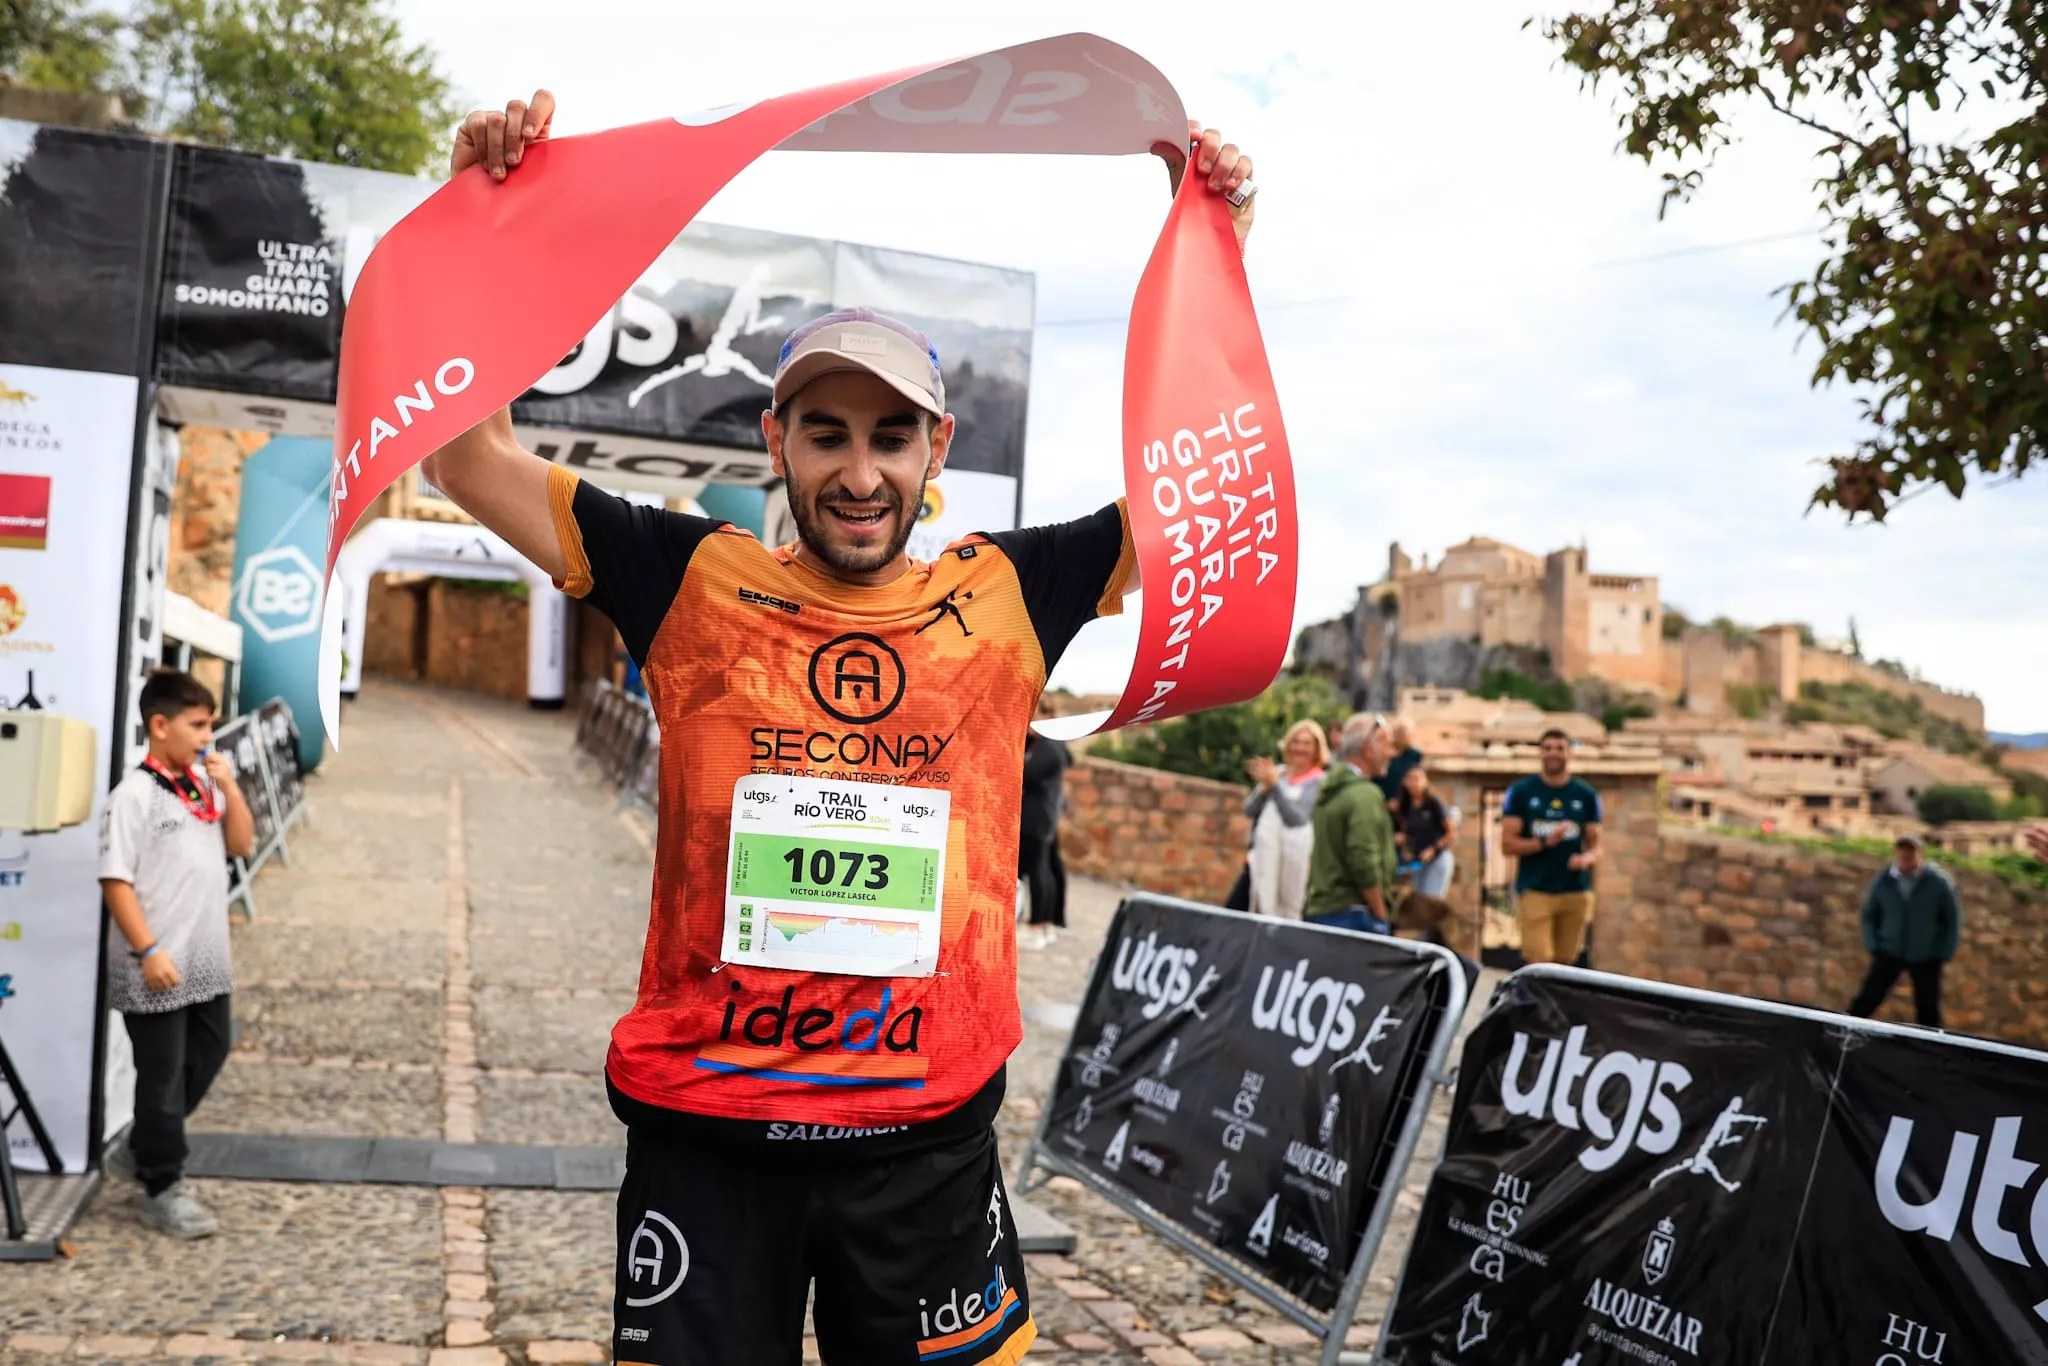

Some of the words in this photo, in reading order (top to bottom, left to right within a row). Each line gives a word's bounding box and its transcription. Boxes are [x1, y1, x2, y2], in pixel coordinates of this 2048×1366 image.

[257, 239, 332, 263] ULTRA
[263, 259, 331, 281] TRAIL
[175, 284, 329, 317] SOMONTANO
[246, 275, 329, 299] GUARA
[1203, 413, 1251, 579] TRAIL
[1233, 403, 1279, 585] ULTRA
[1172, 429, 1224, 628] GUARA
[1126, 440, 1195, 725] SOMONTAN
[750, 727, 954, 768] SECONAY
[744, 790, 770, 804] utgs
[909, 771, 951, 783] AYUSO
[794, 802, 821, 818] RÍO
[825, 806, 866, 821] VERO
[818, 791, 867, 808] TRAIL
[903, 804, 929, 818] utgs
[783, 847, 889, 890] 1073
[790, 887, 819, 897] VICTOR
[821, 889, 846, 899] LÓPEZ
[847, 892, 877, 902] LASECA
[739, 942, 751, 951] C3
[1112, 931, 1198, 1020] utgs
[719, 981, 923, 1053] ideda
[1252, 959, 1366, 1067] utgs
[1500, 1024, 1694, 1173] utgs
[1486, 1199, 1524, 1238] es
[1469, 1244, 1505, 1284] ca
[919, 1264, 1008, 1337] ideda
[1583, 1277, 1703, 1356] ALQUÉZAR
